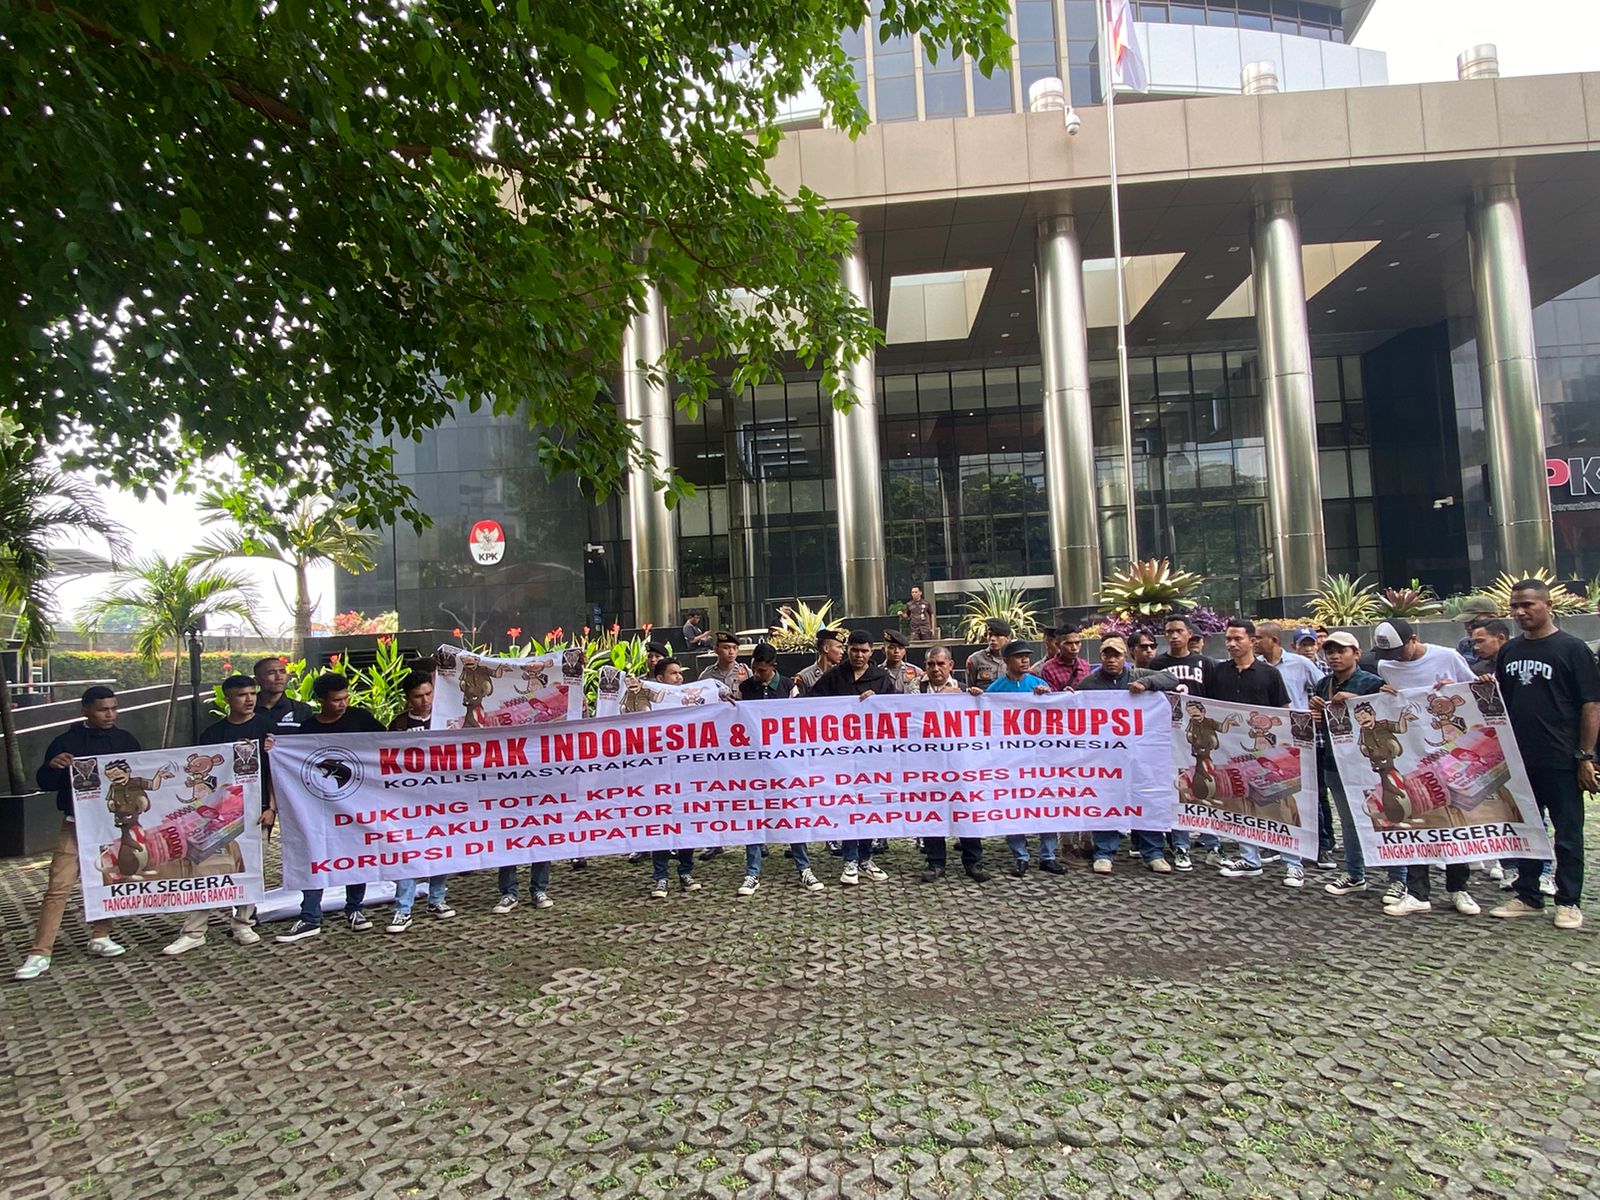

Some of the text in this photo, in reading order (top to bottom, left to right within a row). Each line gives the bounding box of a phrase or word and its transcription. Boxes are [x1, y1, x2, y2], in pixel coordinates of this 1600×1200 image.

[478, 552, 498, 561] KPK
[379, 736, 528, 775] KOMPAK
[540, 720, 719, 764] INDONESIA
[729, 723, 750, 747] &
[761, 711, 912, 746] PENGGIAT
[922, 709, 992, 739] ANTI
[1003, 707, 1144, 737] KORUPSI
[384, 739, 1128, 789] KOALISI MASYARAKAT PEMBERANTASAN KORUPSI INDONESIA
[334, 767, 1123, 826] DUKUNG TOTAL KPK RI TANGKAP DAN PROSES HUKUM
[365, 786, 1098, 845] PELAKU DAN AKTOR INTELEKTUAL TINDAK PIDANA
[1178, 814, 1209, 829] TANGKAP
[1211, 818, 1245, 837] KORUPTOR
[1247, 828, 1266, 842] UANG
[1267, 830, 1294, 849] RAKYAT
[1185, 804, 1291, 835] KPK SEGERA
[311, 805, 1143, 874] KORUPSI DI KABUPATEN TOLIKARA, PAPUA PEGUNUNGAN
[1377, 845, 1415, 859] TANGKAP
[1416, 842, 1459, 857] KORUPTOR
[1459, 839, 1487, 855] UANG
[1488, 837, 1523, 853] RAKYAT
[1382, 823, 1518, 844] KPK SEGERA
[103, 894, 141, 912] TANGKAP
[143, 892, 182, 908] KORUPTOR
[183, 889, 207, 905] UANG
[207, 886, 238, 903] RAKYAT
[111, 875, 234, 897] KPK SEGERA
